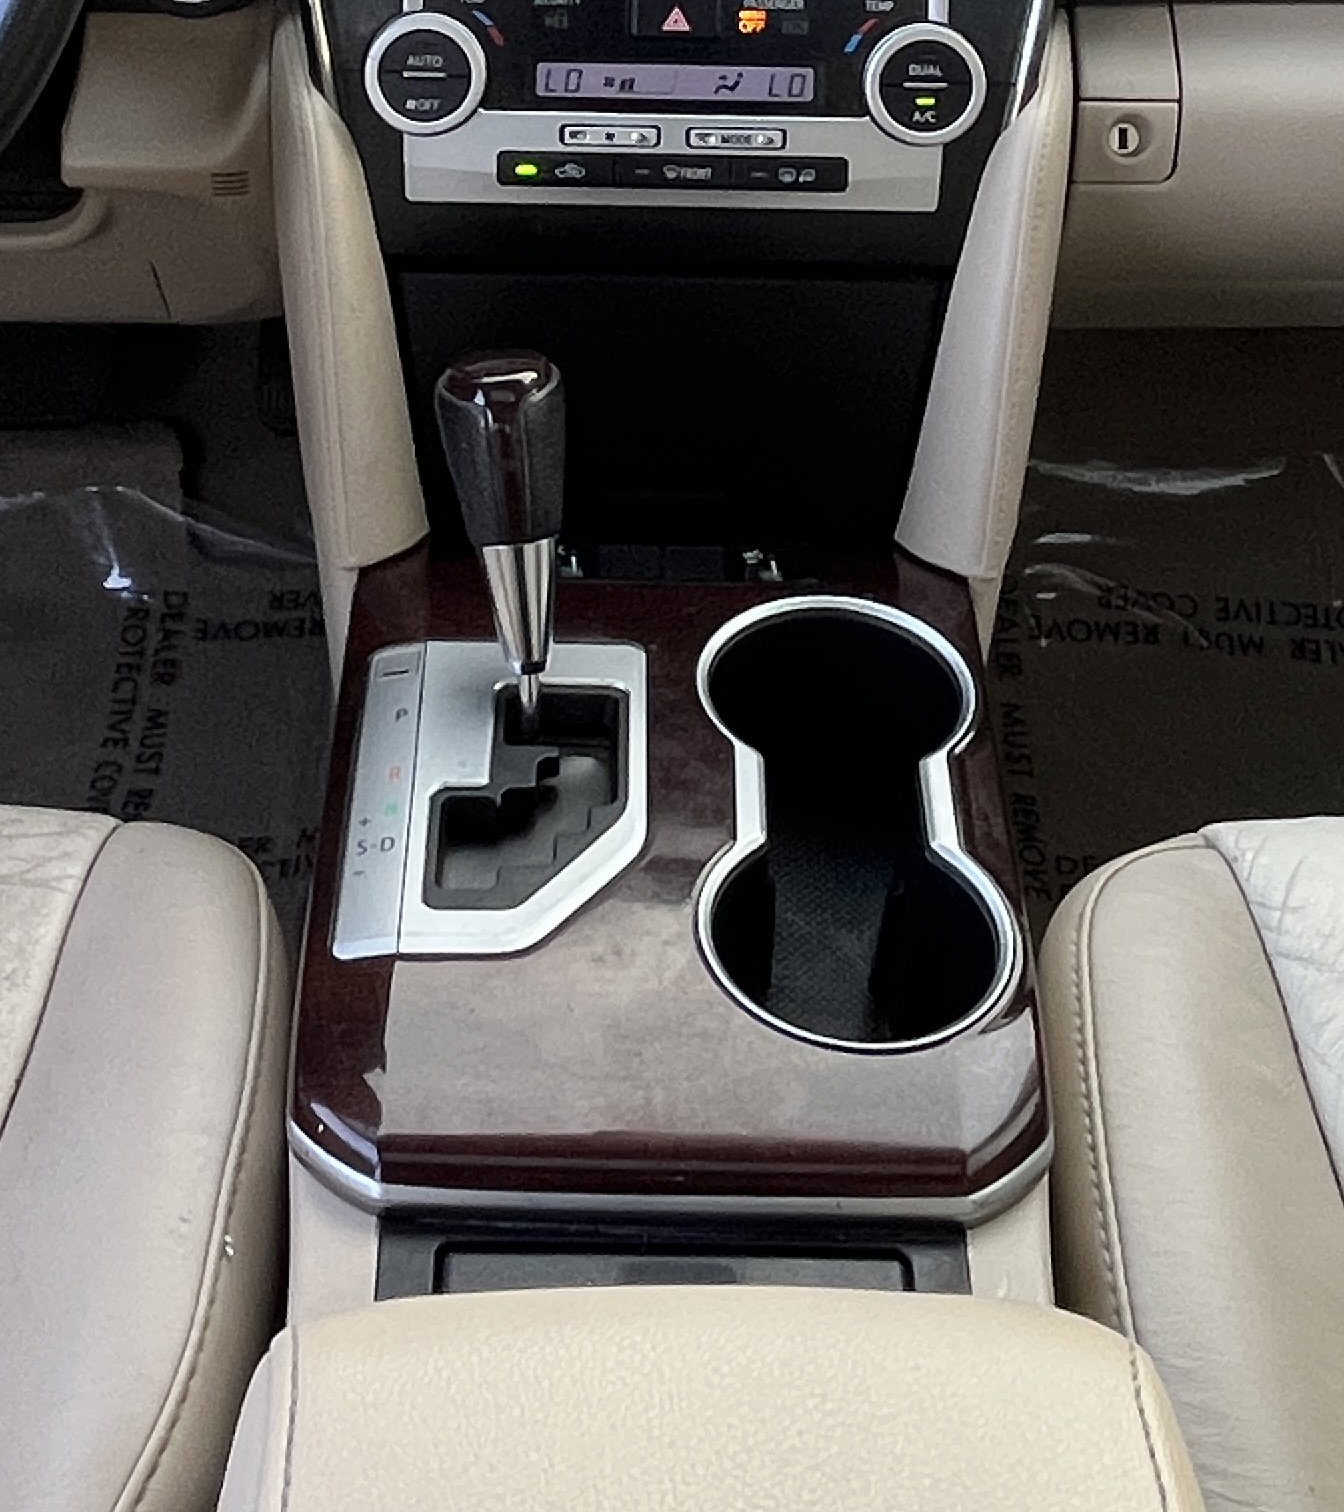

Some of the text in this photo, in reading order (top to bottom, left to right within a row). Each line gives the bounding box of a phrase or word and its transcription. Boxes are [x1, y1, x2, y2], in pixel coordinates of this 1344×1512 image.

[865, 0, 894, 12] TEMP
[406, 54, 444, 68] AUTO
[908, 63, 943, 77] DUAL
[912, 111, 937, 124] A/C
[150, 590, 189, 686] DEALER
[396, 707, 409, 723] P
[132, 707, 170, 777] MUST
[1000, 702, 1035, 779] MUST
[389, 766, 402, 781] R
